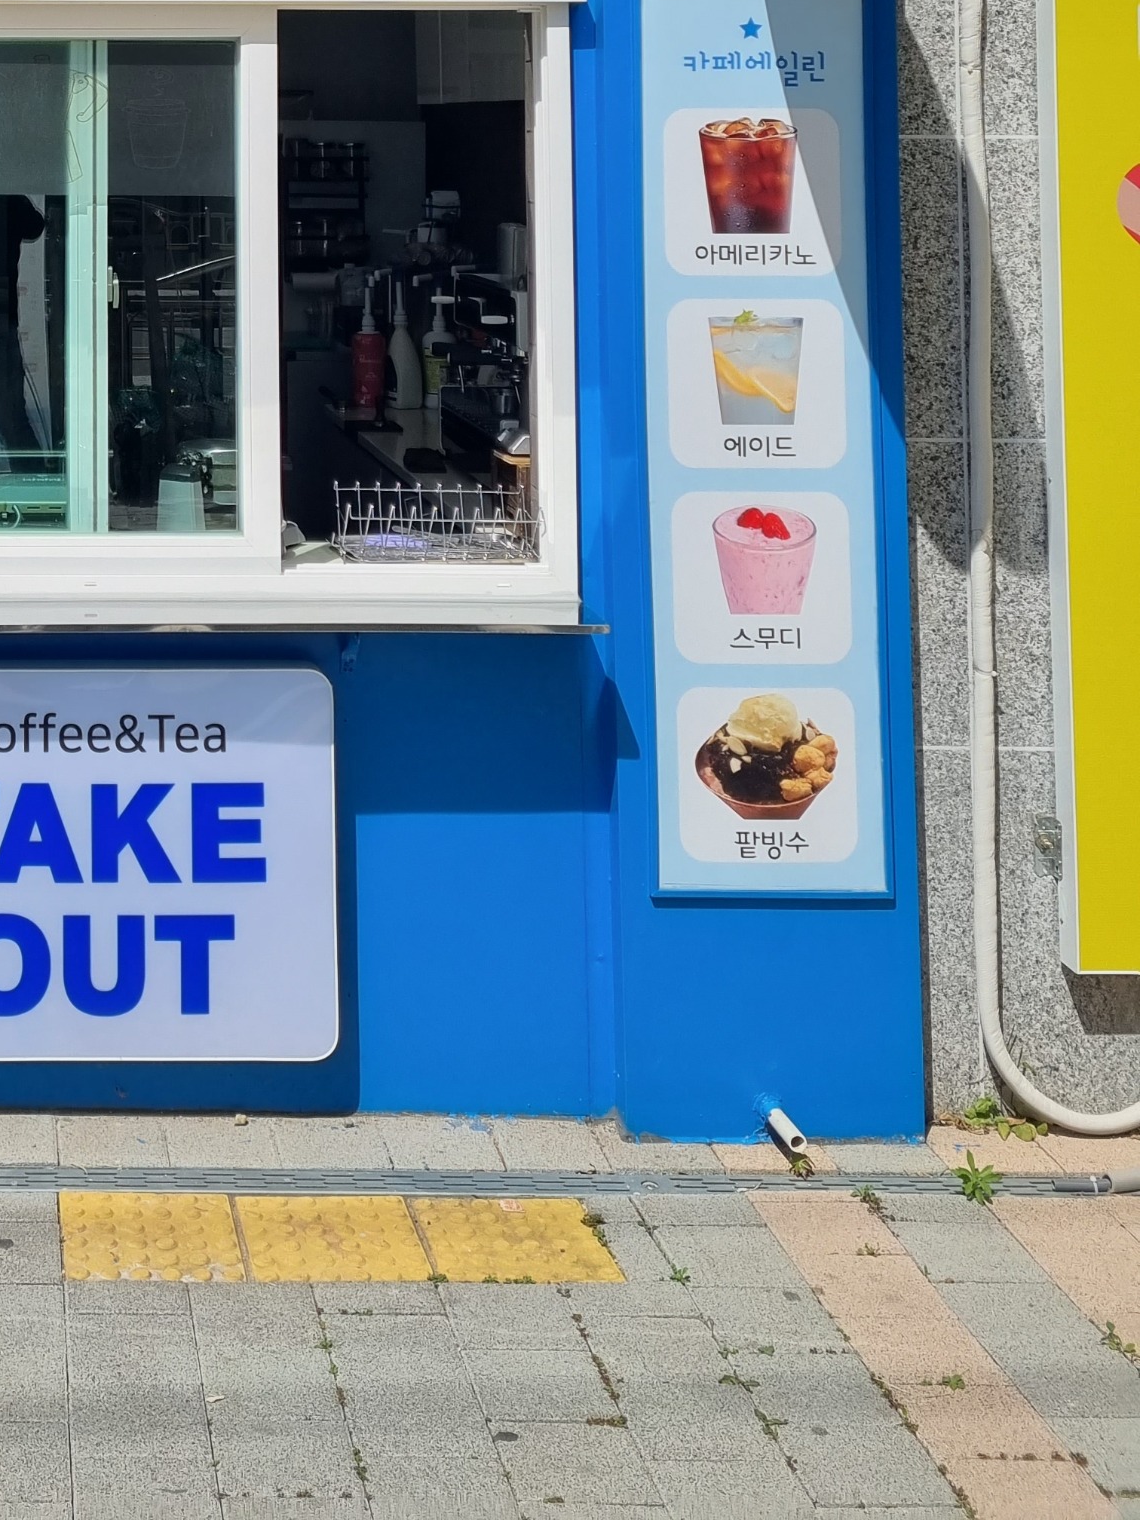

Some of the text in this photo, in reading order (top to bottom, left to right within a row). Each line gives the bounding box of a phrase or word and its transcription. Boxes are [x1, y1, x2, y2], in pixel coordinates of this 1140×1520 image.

[682, 50, 828, 86] 카페에일린
[694, 242, 817, 268] 아메리카노
[722, 434, 797, 459] 에이드
[729, 626, 803, 652] 스무디
[732, 829, 810, 860] 팥빙수
